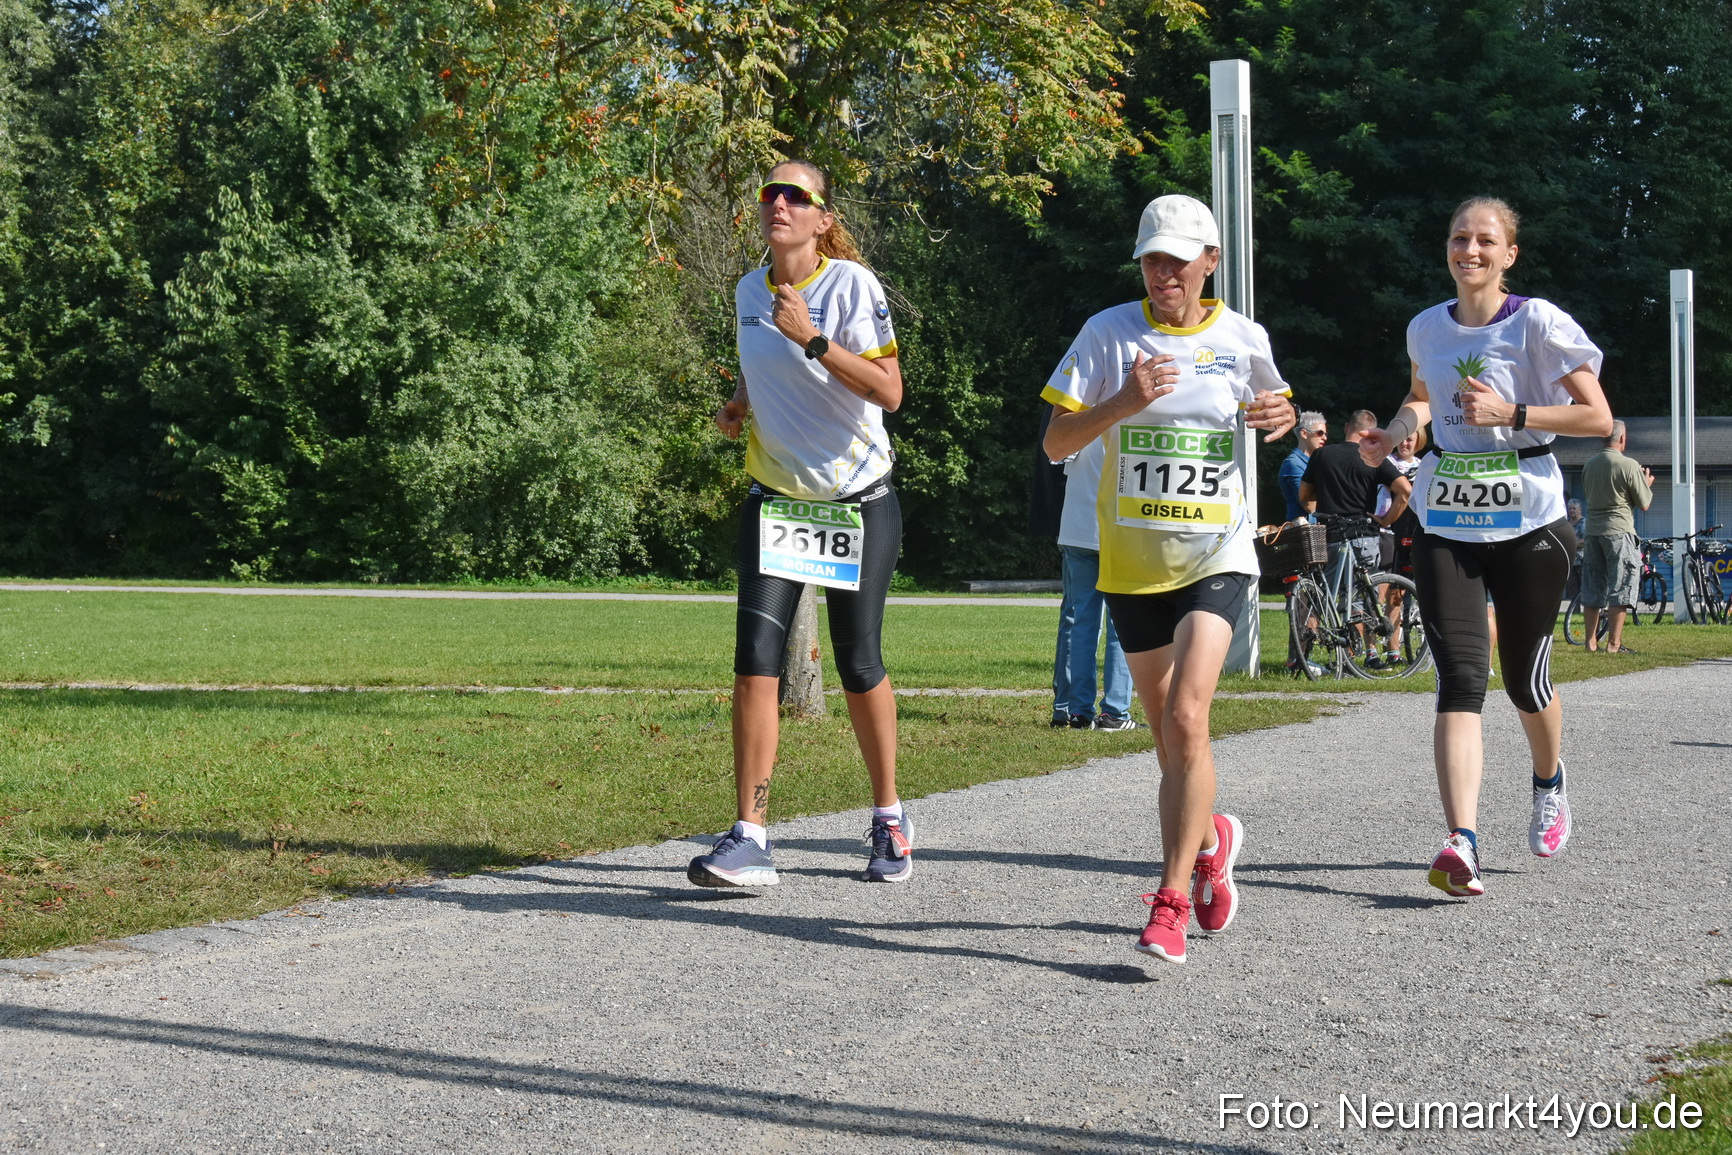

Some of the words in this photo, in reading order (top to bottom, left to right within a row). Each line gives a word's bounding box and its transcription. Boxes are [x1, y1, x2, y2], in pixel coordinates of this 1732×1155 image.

[1195, 362, 1236, 370] Neumarkter
[1196, 351, 1214, 363] 20
[1459, 427, 1474, 436] mit
[1131, 431, 1221, 459] BOCK
[836, 482, 852, 498] 14./15.
[849, 456, 871, 484] September
[868, 443, 877, 456] 2019
[1441, 456, 1508, 476] BOCK
[1133, 461, 1220, 497] 1125
[1436, 482, 1511, 507] 2420
[772, 500, 850, 524] BOCK
[1141, 503, 1205, 520] GISELA
[1455, 514, 1495, 526] ANJA
[772, 525, 851, 558] 2618
[782, 558, 836, 577] MORAN
